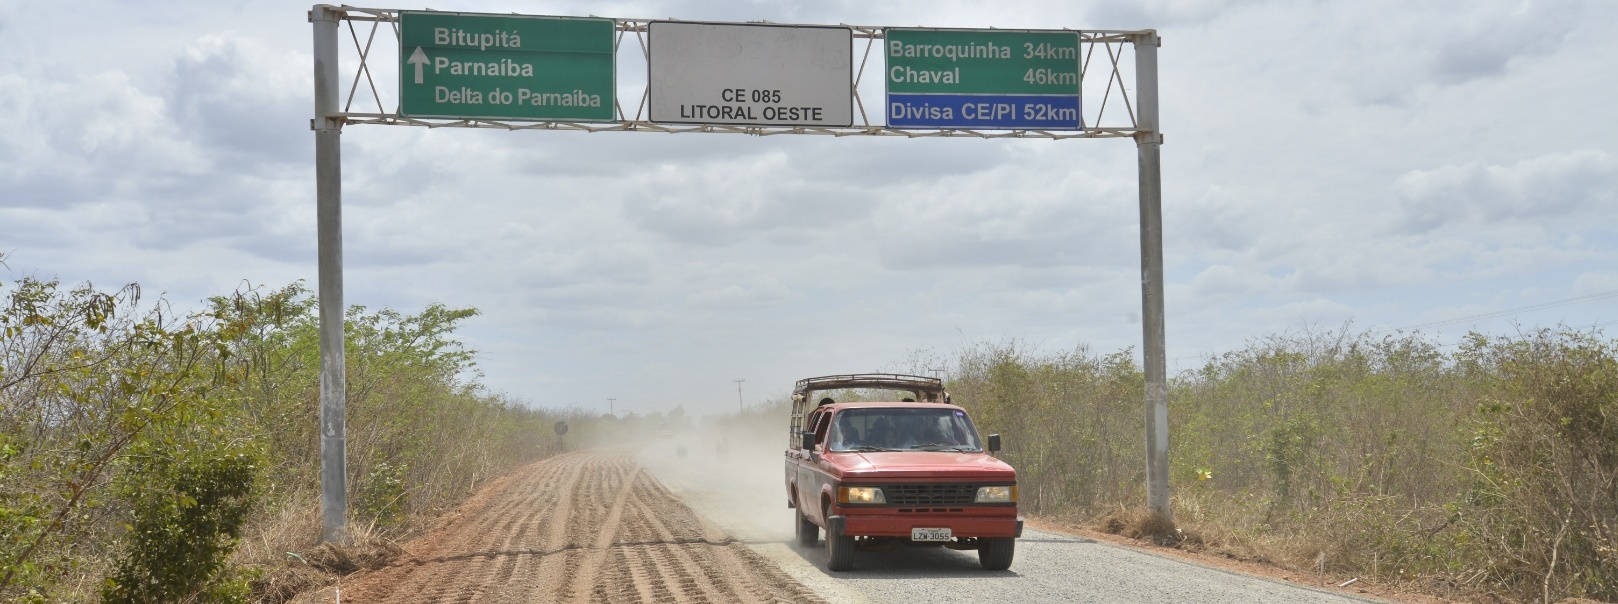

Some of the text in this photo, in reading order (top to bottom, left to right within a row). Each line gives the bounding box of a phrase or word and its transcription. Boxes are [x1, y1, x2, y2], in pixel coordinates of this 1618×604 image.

[434, 27, 521, 51] Bitupitá
[890, 40, 1076, 61] Barroquinha 34km
[434, 57, 534, 77] Parnaíba
[890, 66, 1077, 85] Chaval 46km
[435, 86, 601, 108] Delta do Parnaíba
[721, 88, 781, 103] CE 085
[680, 104, 823, 121] LITORAL OESTE
[891, 102, 1077, 121] Divisa CE/PI 52km
